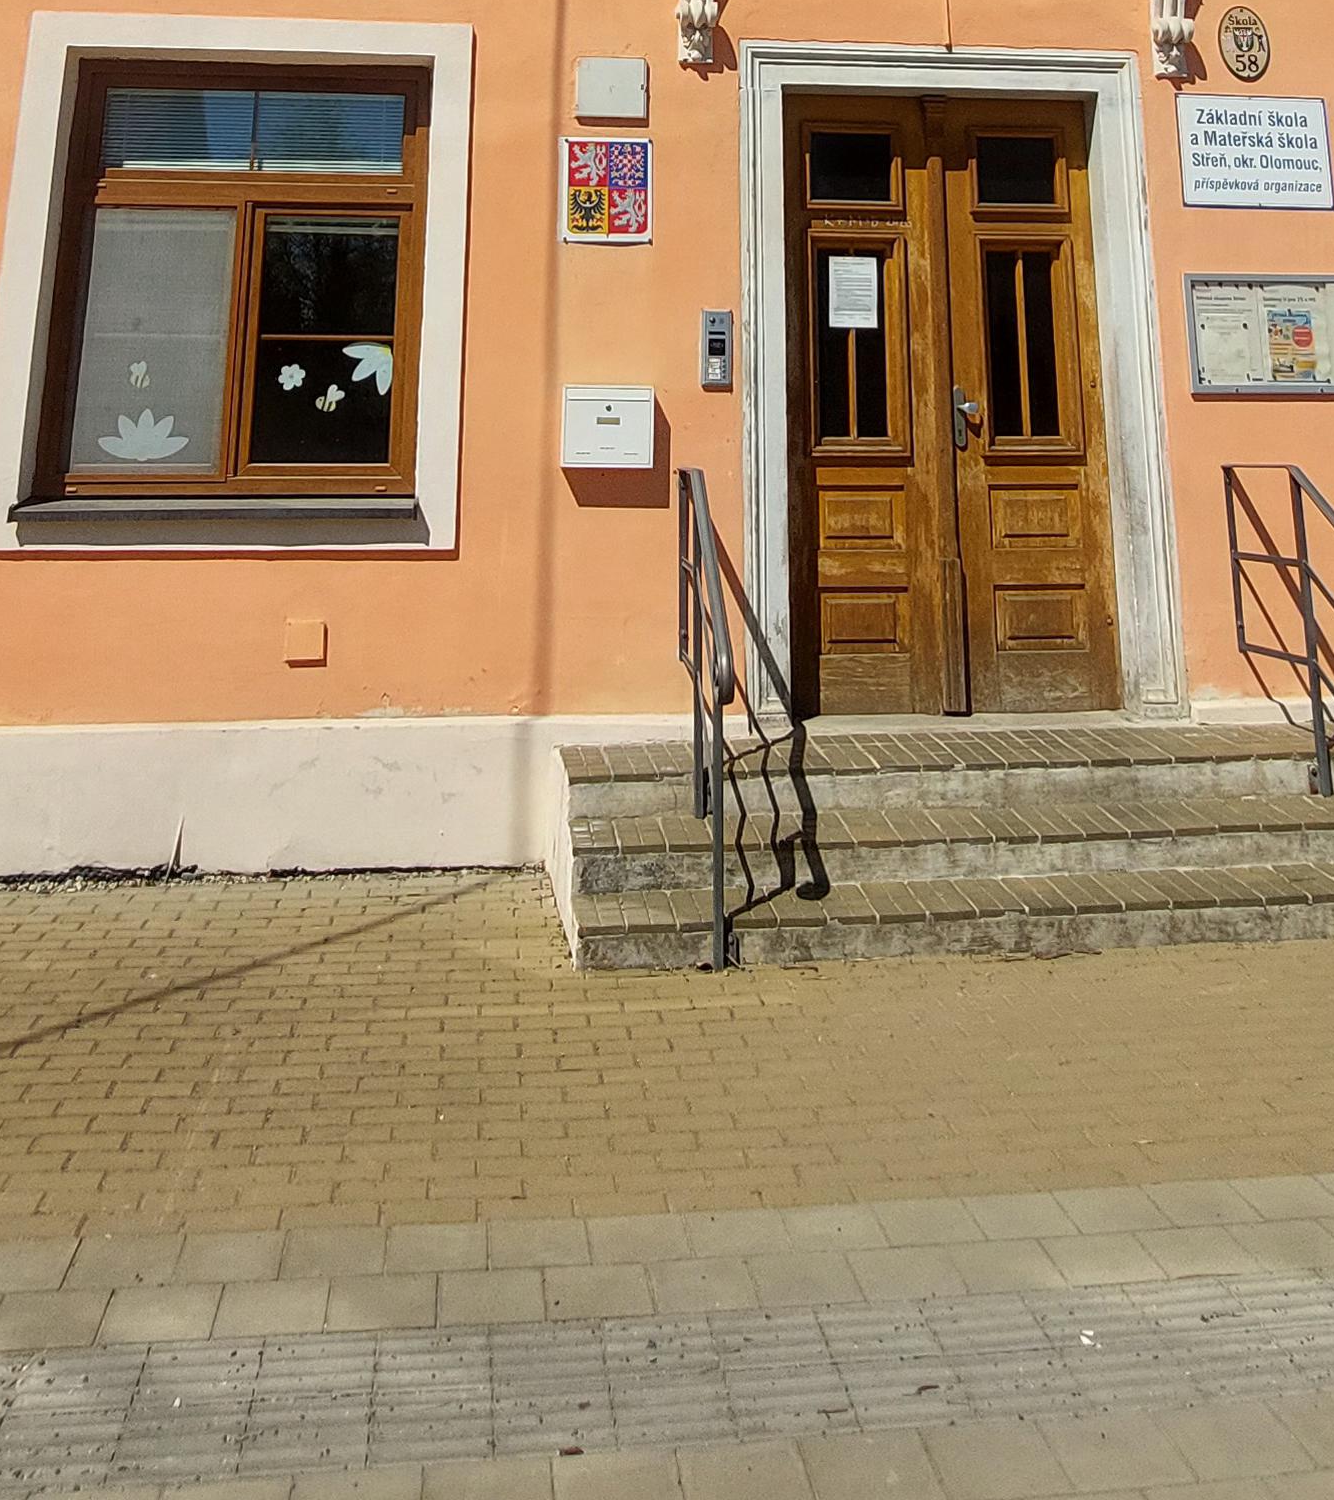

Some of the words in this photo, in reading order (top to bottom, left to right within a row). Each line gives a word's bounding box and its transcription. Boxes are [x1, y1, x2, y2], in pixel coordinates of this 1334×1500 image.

[1227, 14, 1258, 26] Škola
[1235, 54, 1260, 73] 58
[1195, 108, 1263, 126] Základní
[1267, 110, 1308, 128] škola
[1190, 132, 1199, 146] a
[1203, 130, 1274, 149] Mateřská
[1277, 132, 1318, 150] škola
[1191, 152, 1231, 170] Střeň,
[1233, 154, 1257, 169] okr.
[1259, 154, 1323, 173] Olomouc,
[1193, 177, 1260, 193] příspěvková
[1263, 180, 1323, 194] organizace
